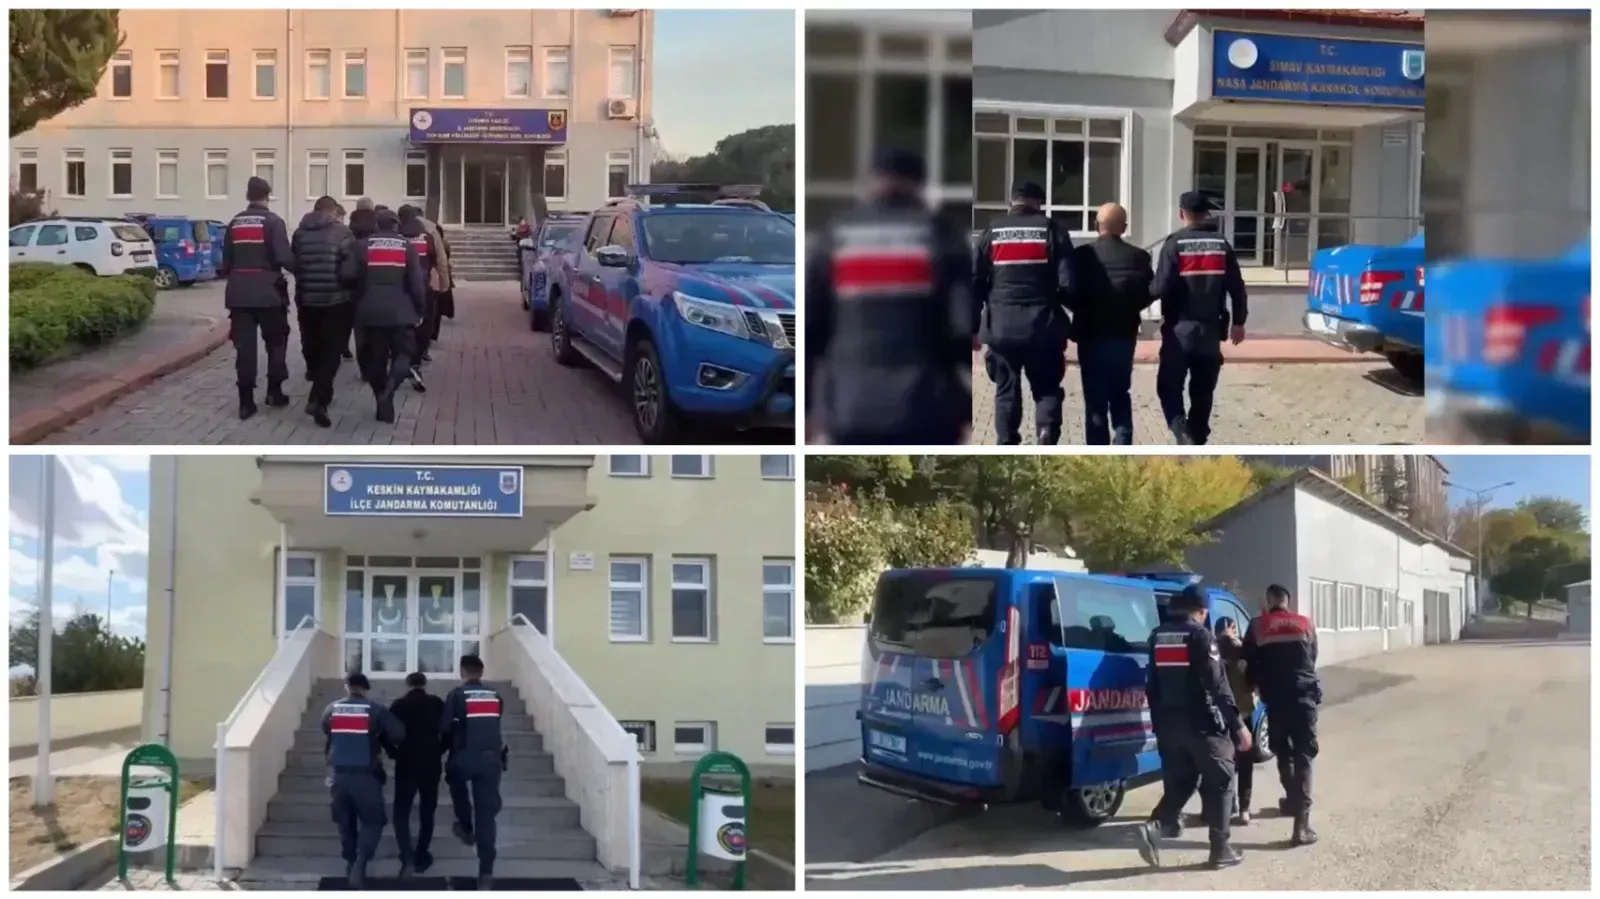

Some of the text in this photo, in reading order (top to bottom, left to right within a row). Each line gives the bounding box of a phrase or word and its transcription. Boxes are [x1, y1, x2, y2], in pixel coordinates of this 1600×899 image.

[1249, 79, 1308, 92] JANDARMA
[416, 470, 434, 481] T.C.
[366, 482, 481, 496] KESKİN KAYMAKAMLIĞI
[350, 497, 497, 511] İLÇE JANDARMA KOMUTANLIĞI
[883, 688, 950, 715] JANDARMA
[1075, 689, 1149, 711] JANDAR
